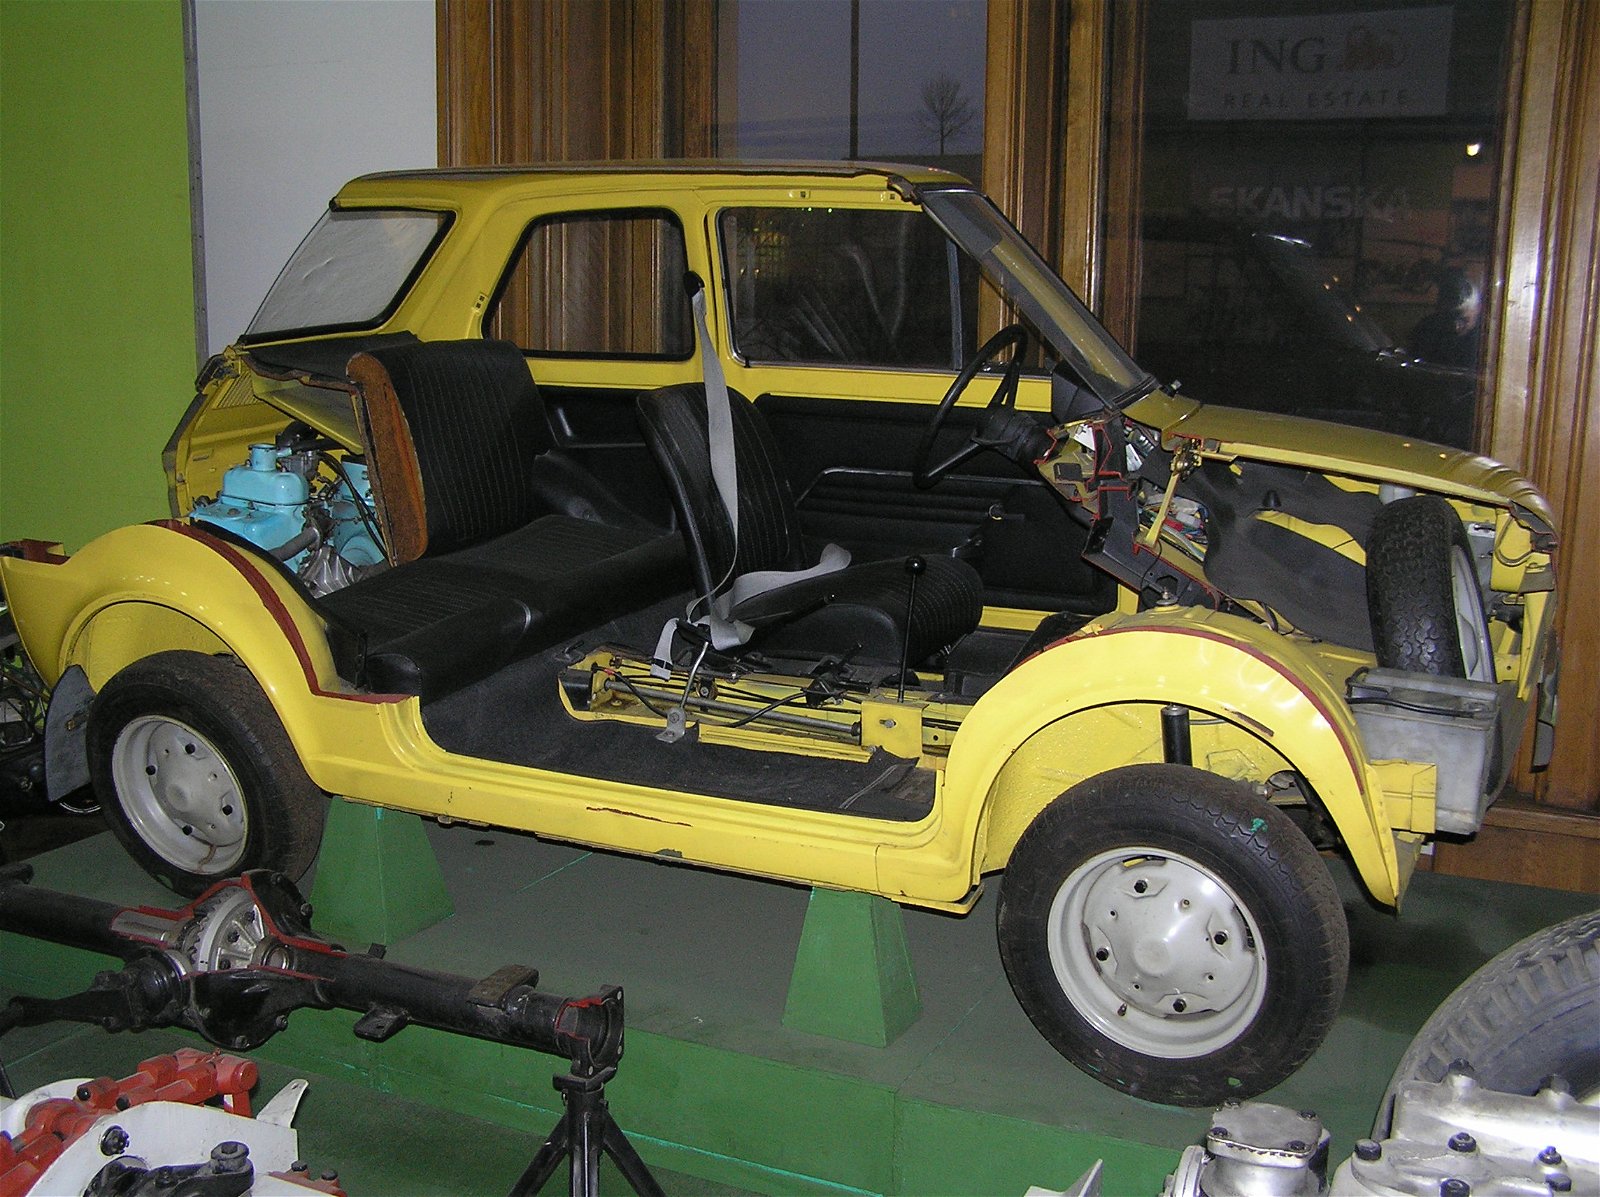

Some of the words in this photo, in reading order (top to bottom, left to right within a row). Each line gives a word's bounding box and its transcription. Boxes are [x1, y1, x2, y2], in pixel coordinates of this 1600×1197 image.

[1228, 36, 1327, 75] ING
[1224, 92, 1291, 109] REAL
[1307, 89, 1408, 107] ESTATE
